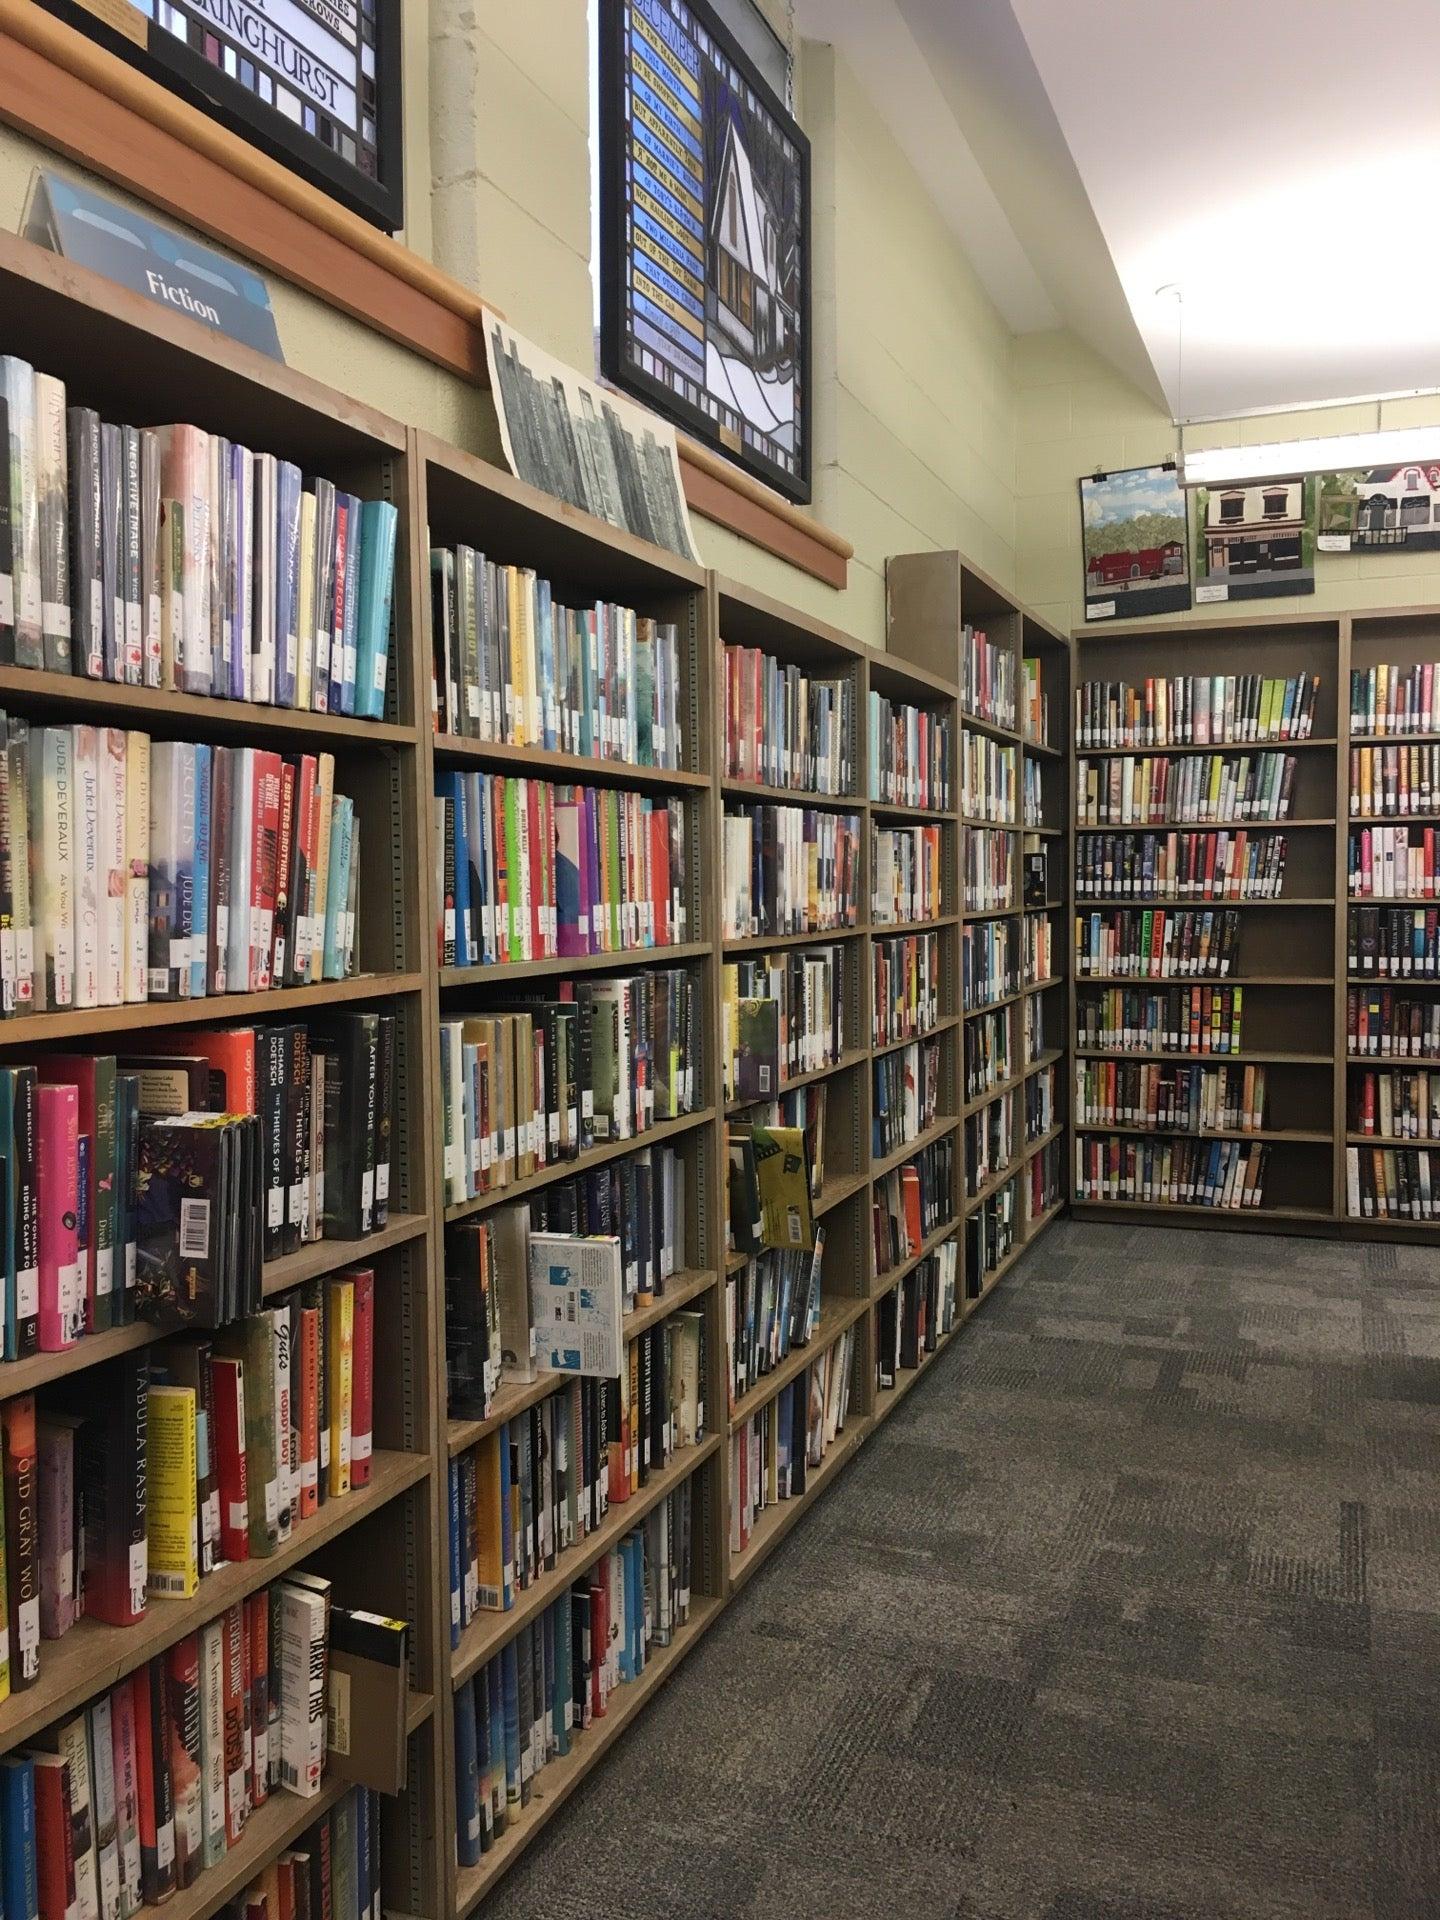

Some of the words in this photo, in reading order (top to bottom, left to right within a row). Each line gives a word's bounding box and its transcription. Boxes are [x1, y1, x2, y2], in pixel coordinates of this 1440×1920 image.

[195, 0, 339, 110] RINGHURST
[644, 45, 658, 71] THIS
[661, 65, 681, 96] MONTH
[660, 43, 680, 75] SEASON
[634, 97, 645, 119] BUT
[653, 76, 678, 112] SHOPPING
[635, 230, 646, 249] OUT
[645, 217, 657, 237] TWO
[146, 269, 220, 325] Fiction
[91, 423, 100, 463] AMONG
[92, 465, 101, 485] THE
[127, 440, 139, 509] NEGATIVE
[129, 511, 140, 560] IMAGE
[336, 570, 345, 626] BEFORE
[56, 736, 68, 775] JUDE
[139, 744, 147, 776] JUDE
[82, 769, 97, 808] Jude
[113, 765, 125, 801] Jude
[181, 755, 196, 847] SECRETS
[256, 778, 266, 821] William
[264, 773, 274, 810] DEVERELL
[272, 777, 281, 810] WILLIAM
[57, 779, 69, 862] DEVERAUX
[138, 780, 148, 849] DEVERAUX
[282, 782, 293, 831] SISTERS
[445, 802, 455, 841] JEFFREY
[85, 810, 97, 873] Deveraux
[114, 804, 125, 865] Deveraux
[500, 816, 508, 863] EVANOVICH
[279, 831, 290, 890] BROTHERS
[445, 843, 455, 894] EUGENIDES
[60, 889, 68, 909] You
[180, 875, 193, 907] JUDE
[1154, 912, 1163, 935] PETER
[1153, 936, 1162, 959] JAMES
[243, 1048, 253, 1074] cory
[269, 1036, 279, 1087] DOETSCH
[276, 1037, 285, 1084] RICHARD
[292, 1032, 302, 1085] DOETSCH
[299, 1032, 308, 1085] RICHARD
[368, 1044, 378, 1082] AFTER
[25, 1080, 34, 1110] ANTON
[245, 1075, 253, 1112] doctor
[366, 1083, 377, 1108] YOU
[65, 1116, 76, 1152] SWIFT
[97, 1102, 109, 1140] GIRL
[107, 1080, 117, 1159] OLEANDER
[271, 1109, 282, 1155] THIEVES
[294, 1109, 304, 1163] THIEVES
[365, 1110, 375, 1132] DIE
[271, 1157, 280, 1173] OF
[365, 1137, 375, 1159] EVA
[65, 1154, 76, 1200] JUSTICE
[23, 1185, 32, 1222] RIDING
[30, 1196, 38, 1218] THE
[23, 1223, 32, 1253] CAMP
[30, 1220, 38, 1268] YONAHLO
[98, 1218, 109, 1249] Divak
[274, 1323, 292, 1371] Guts
[135, 1366, 148, 1452] TABULA
[279, 1388, 290, 1435] RODDY
[280, 1437, 290, 1466] DOY
[18, 1457, 32, 1500] OLD
[135, 1459, 148, 1517] RASA
[19, 1505, 35, 1558] GRAY
[20, 1564, 34, 1598] WO
[228, 1608, 241, 1654] STEVEN
[229, 1655, 243, 1699] DUNNE
[309, 1688, 323, 1725] THIS
[75, 1740, 88, 1788] HELEN
[211, 1753, 224, 1795] Sarah
[163, 1771, 171, 1813] MATTHEW
